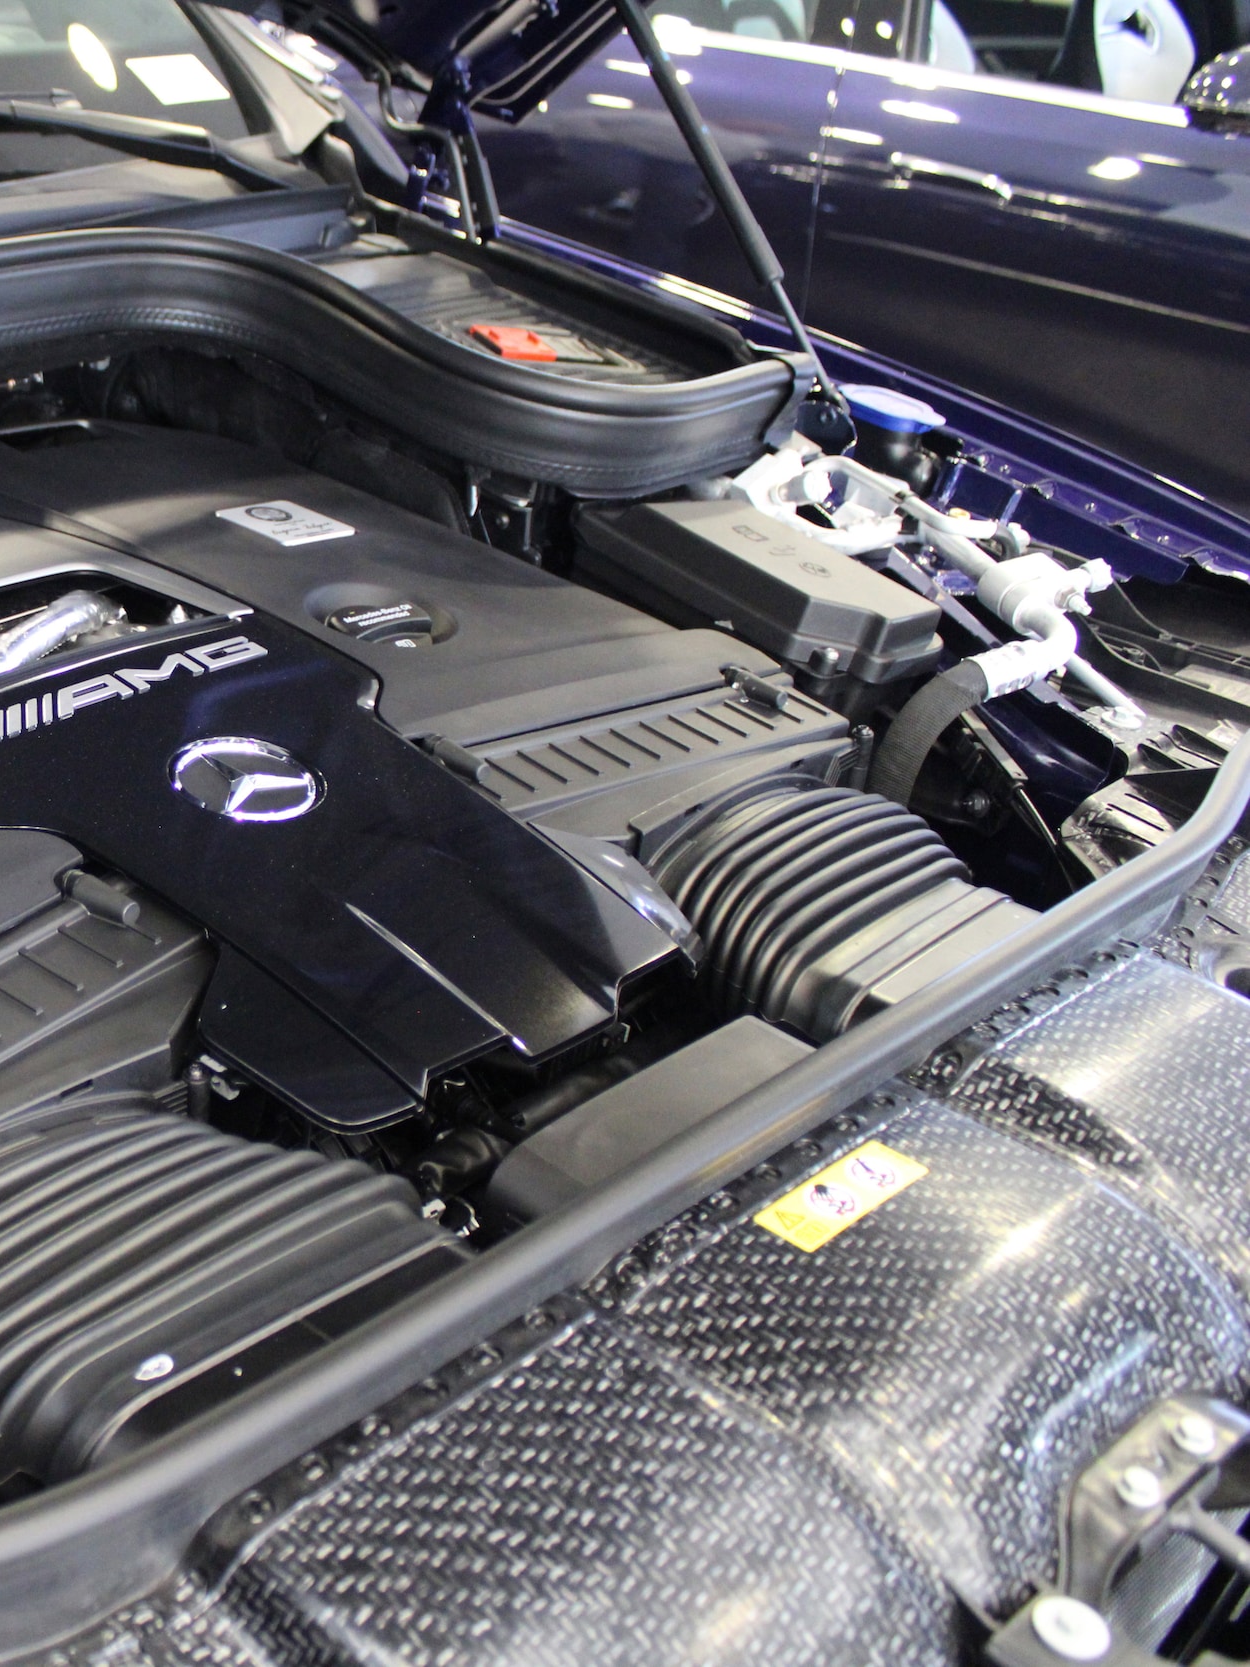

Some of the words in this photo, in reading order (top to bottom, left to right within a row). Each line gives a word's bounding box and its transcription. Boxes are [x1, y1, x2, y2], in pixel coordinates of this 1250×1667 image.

[343, 606, 401, 623] Mercedes-Benz
[358, 611, 410, 627] recommended
[57, 635, 268, 719] AMG
